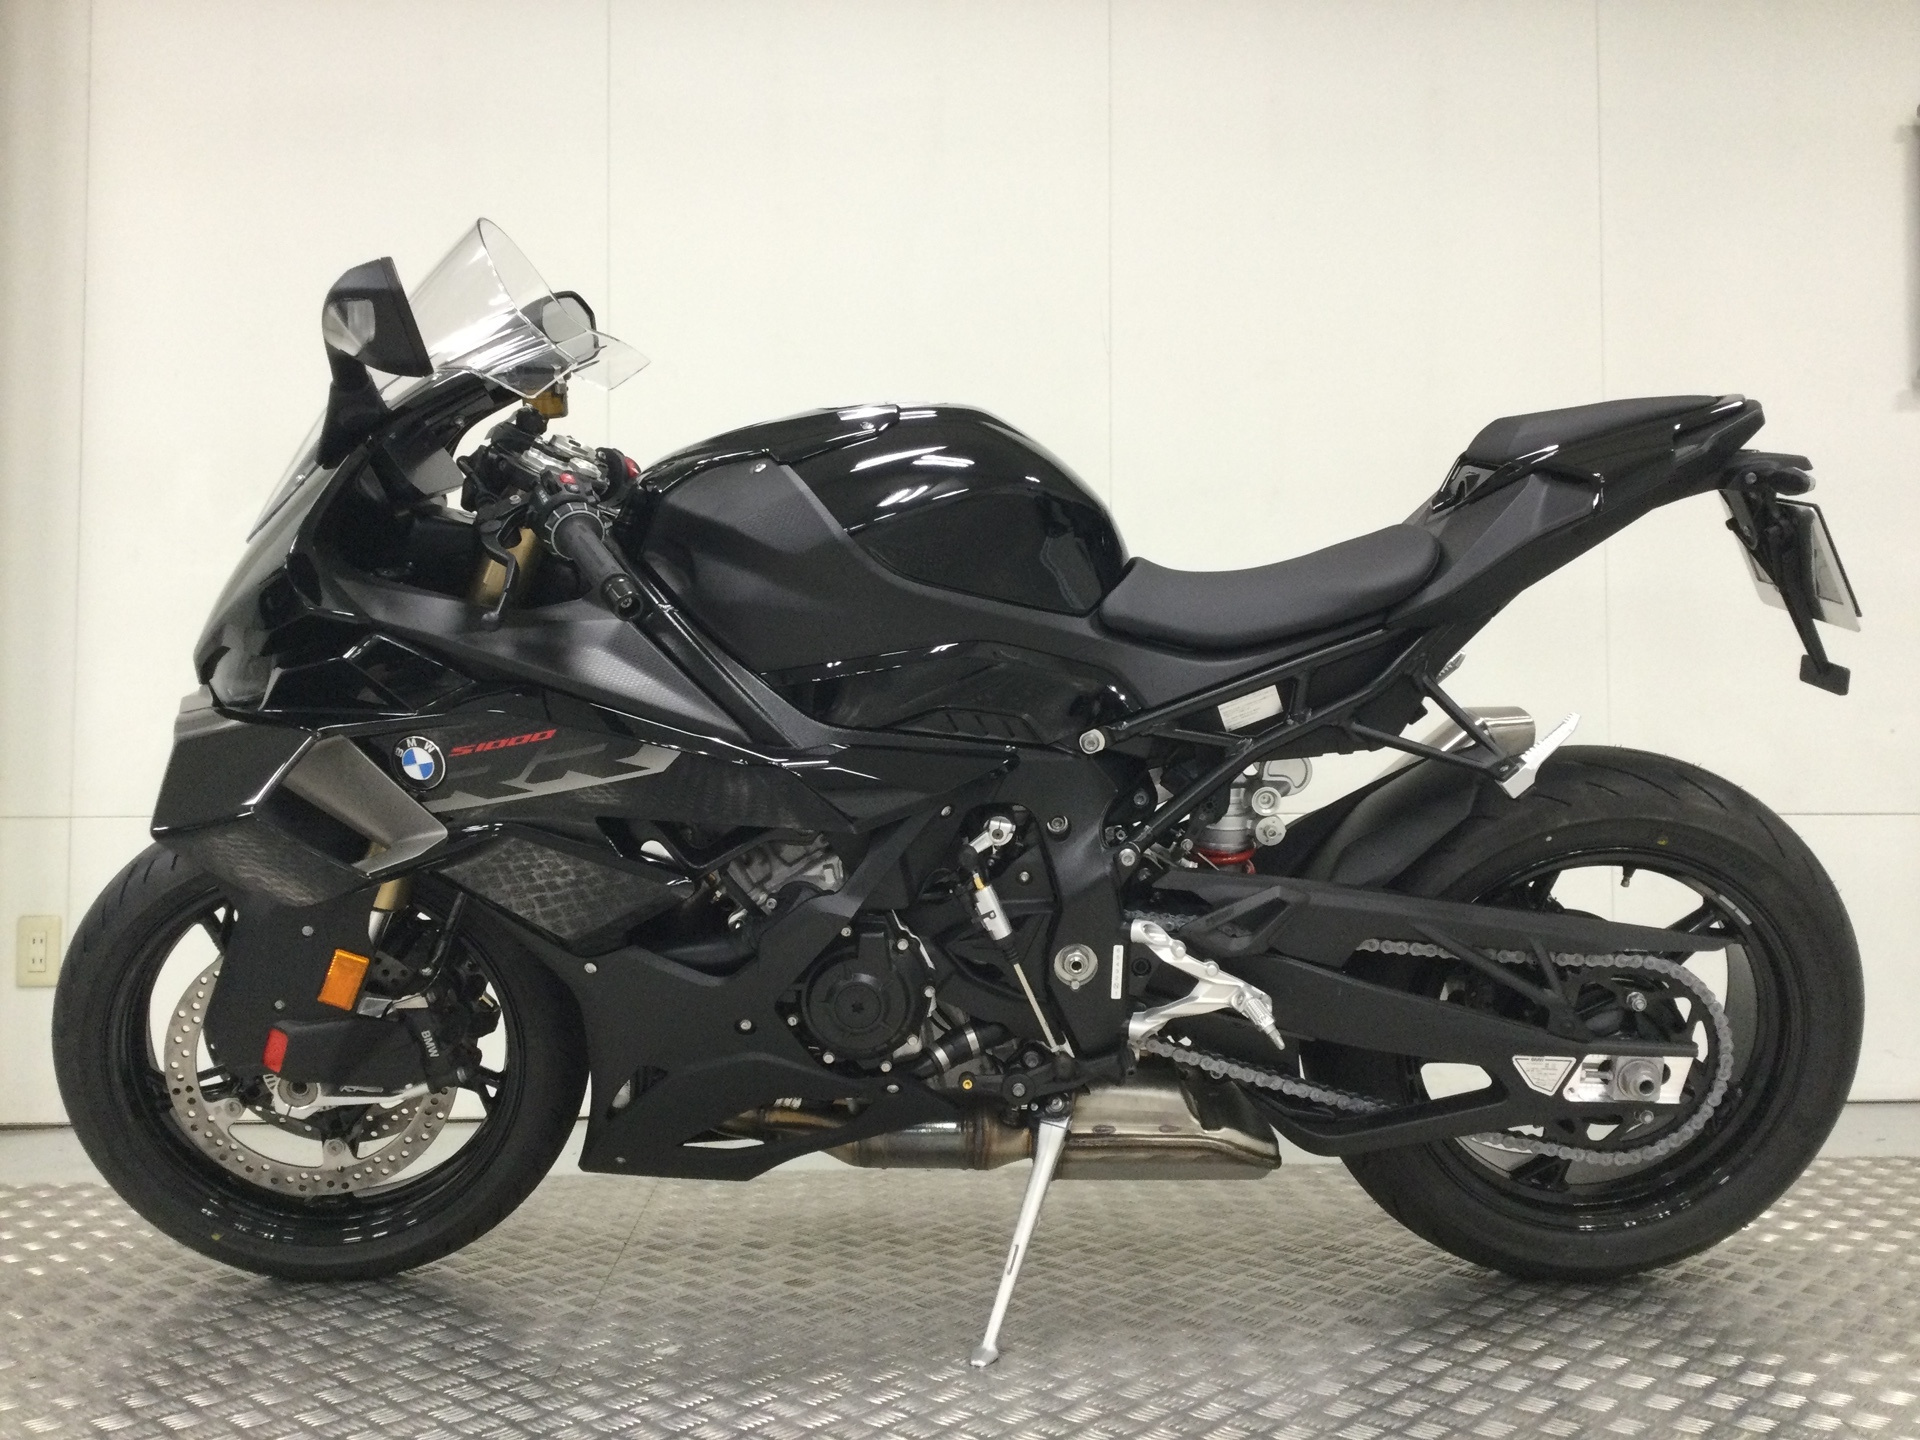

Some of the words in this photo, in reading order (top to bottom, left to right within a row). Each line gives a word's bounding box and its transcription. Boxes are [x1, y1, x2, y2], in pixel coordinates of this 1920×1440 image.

[395, 737, 436, 758] BMW
[449, 729, 557, 757] S1000
[421, 1030, 440, 1058] BMW
